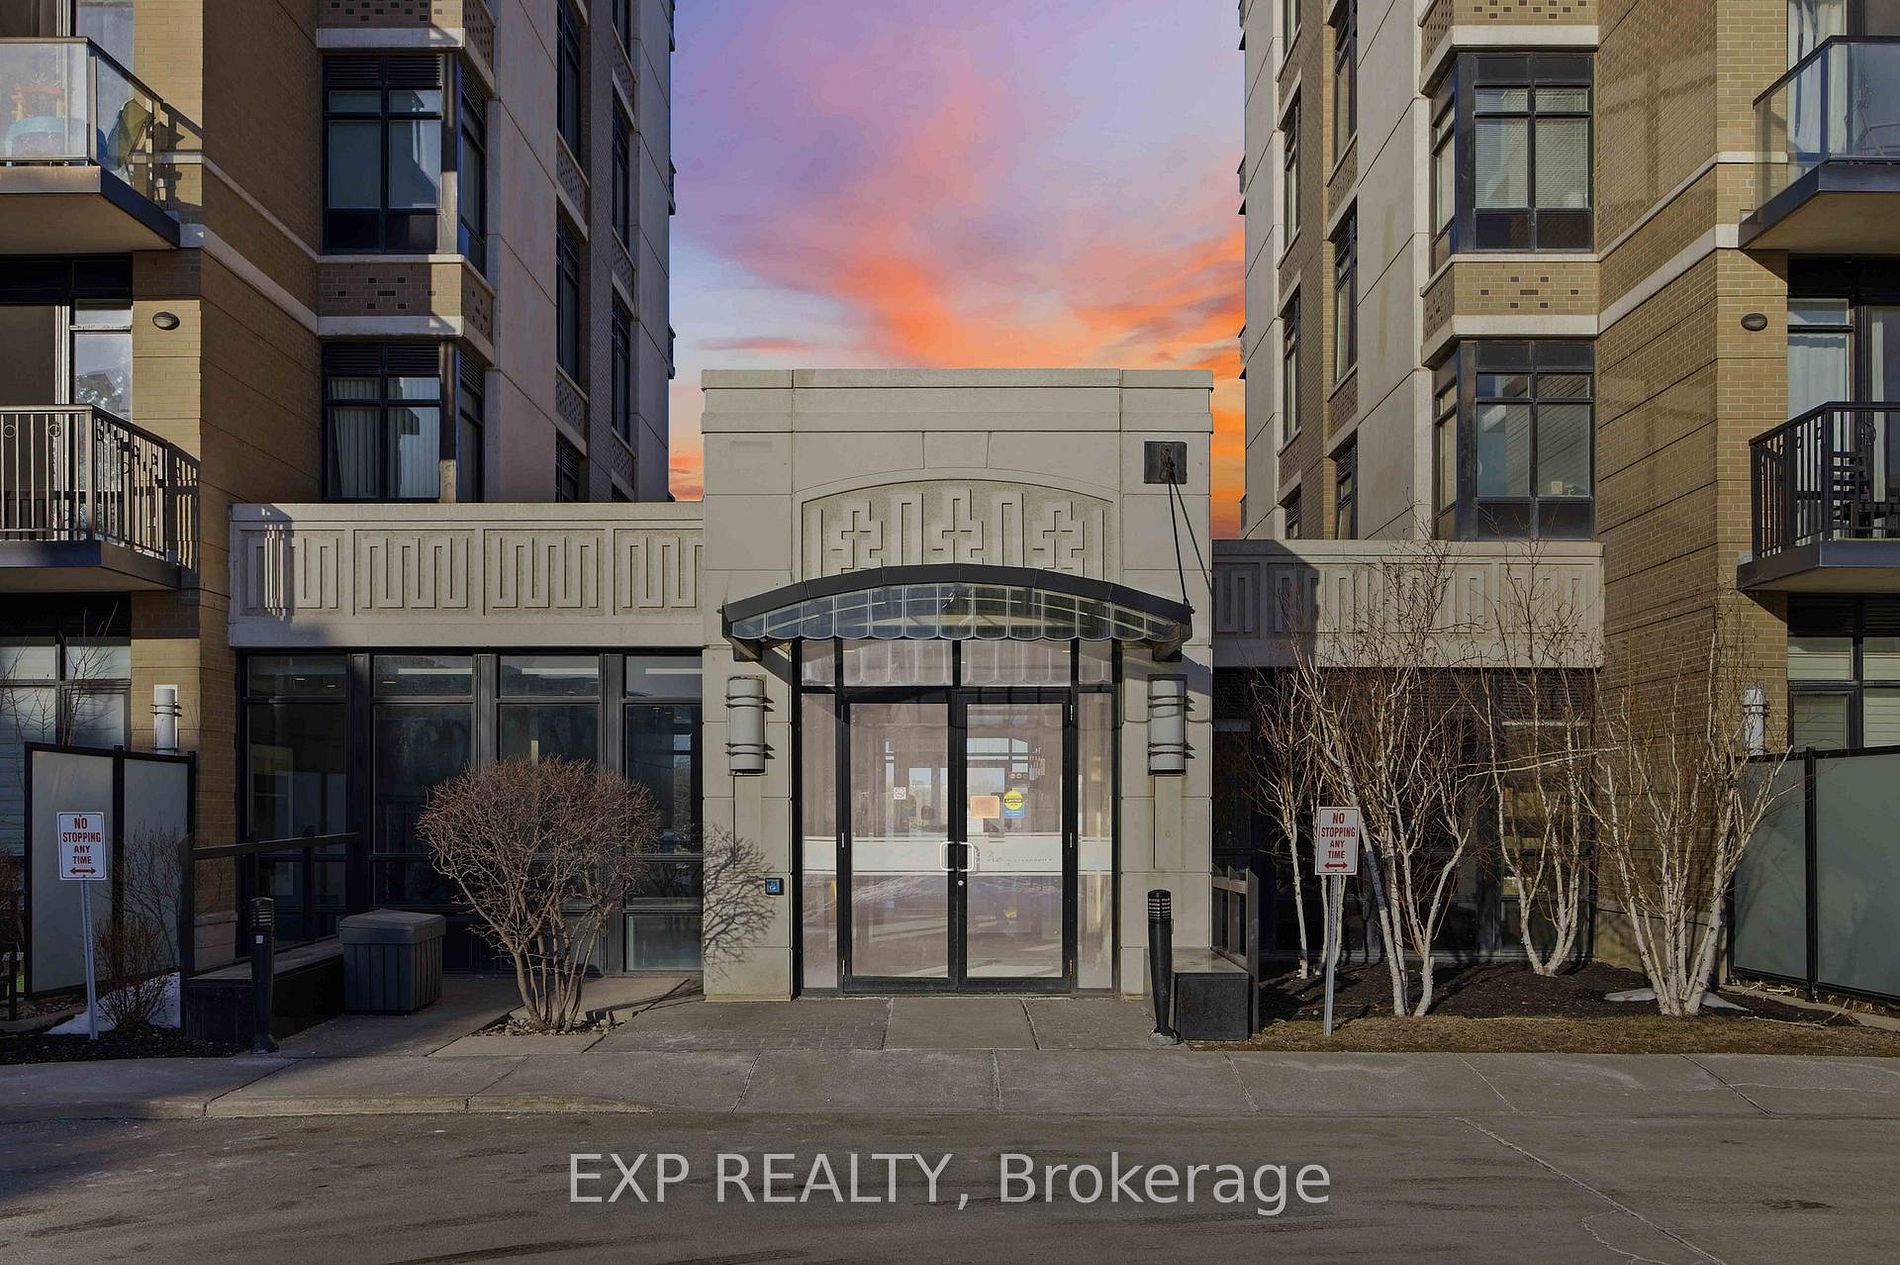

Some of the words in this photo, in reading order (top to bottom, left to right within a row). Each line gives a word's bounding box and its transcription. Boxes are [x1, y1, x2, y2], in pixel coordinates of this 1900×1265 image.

[74, 817, 88, 829] NO
[1332, 813, 1345, 825] NO
[1321, 826, 1356, 838] STOPPING
[62, 832, 101, 843] STOPPING
[1329, 840, 1345, 848] ANY
[74, 845, 91, 854] ANY
[1328, 850, 1346, 859] TIME
[73, 855, 92, 864] TIME
